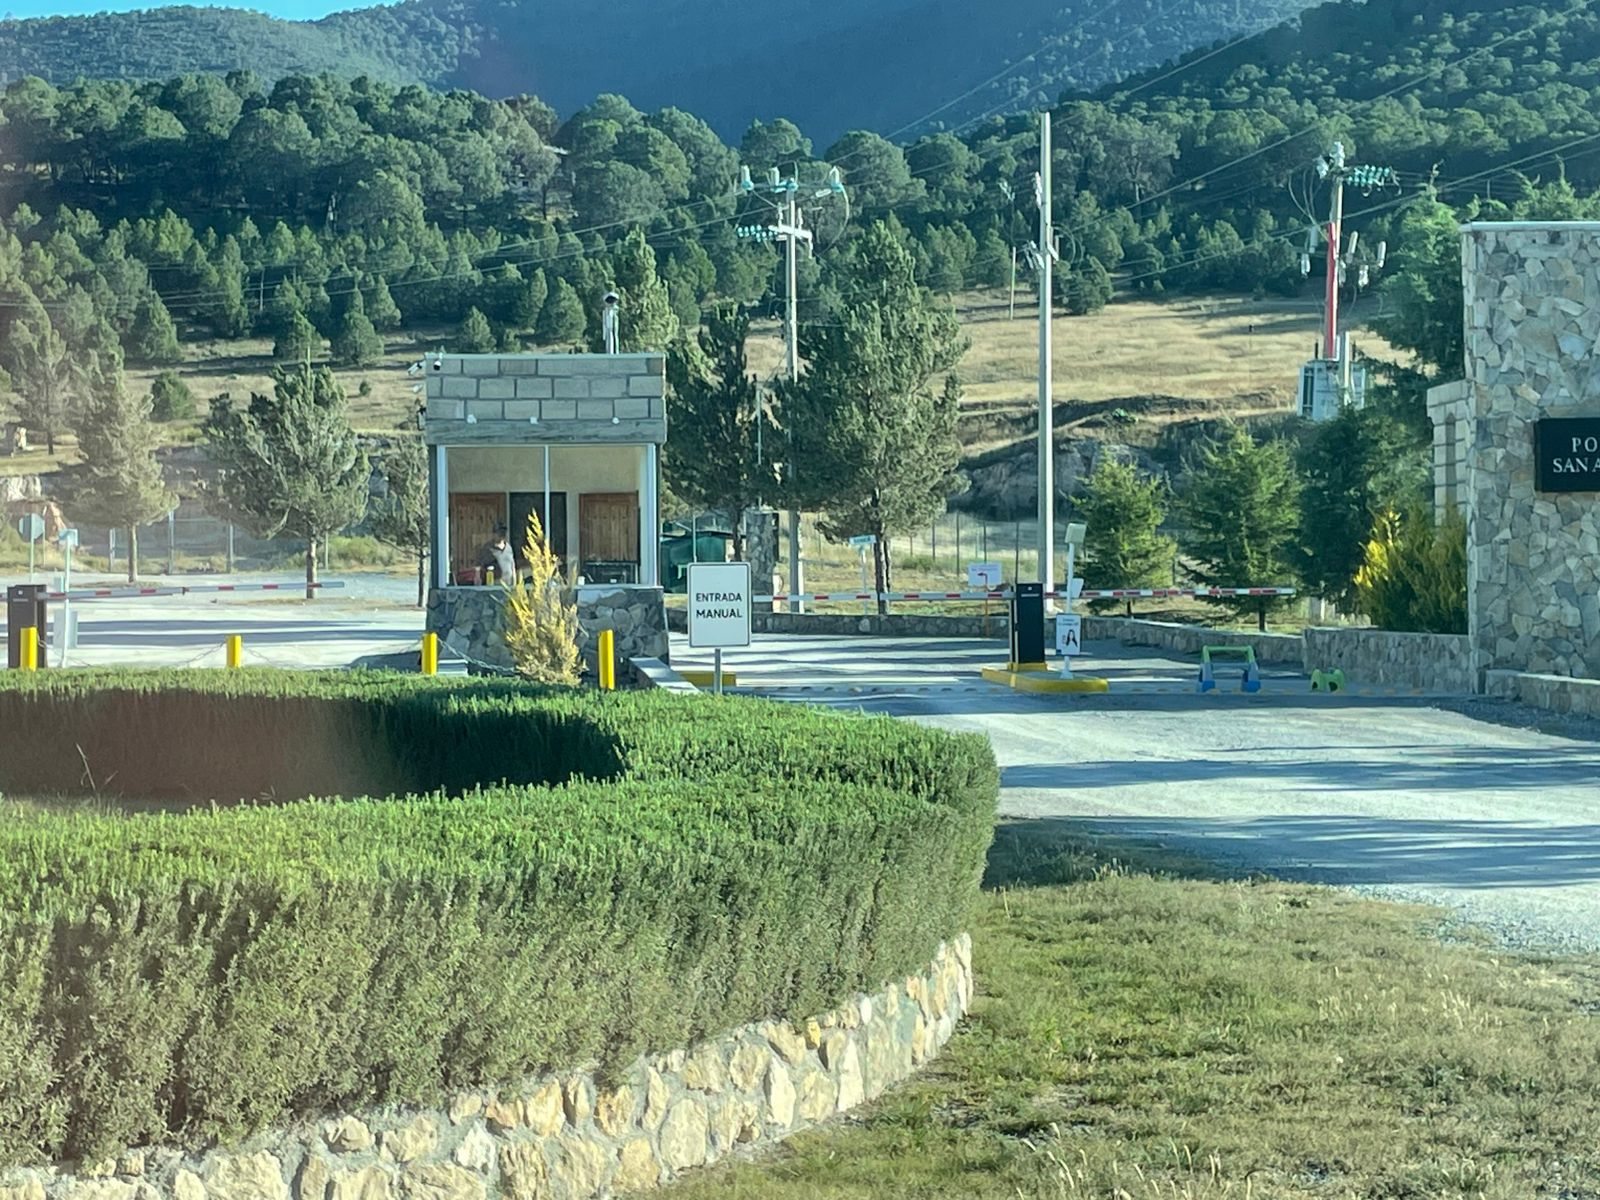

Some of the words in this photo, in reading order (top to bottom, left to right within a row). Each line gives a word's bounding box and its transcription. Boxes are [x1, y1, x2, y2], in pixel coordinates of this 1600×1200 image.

[1572, 436, 1598, 452] PO
[1553, 457, 1588, 473] SAN
[695, 592, 742, 602] ENTRADA
[696, 608, 742, 618] MANUAL
